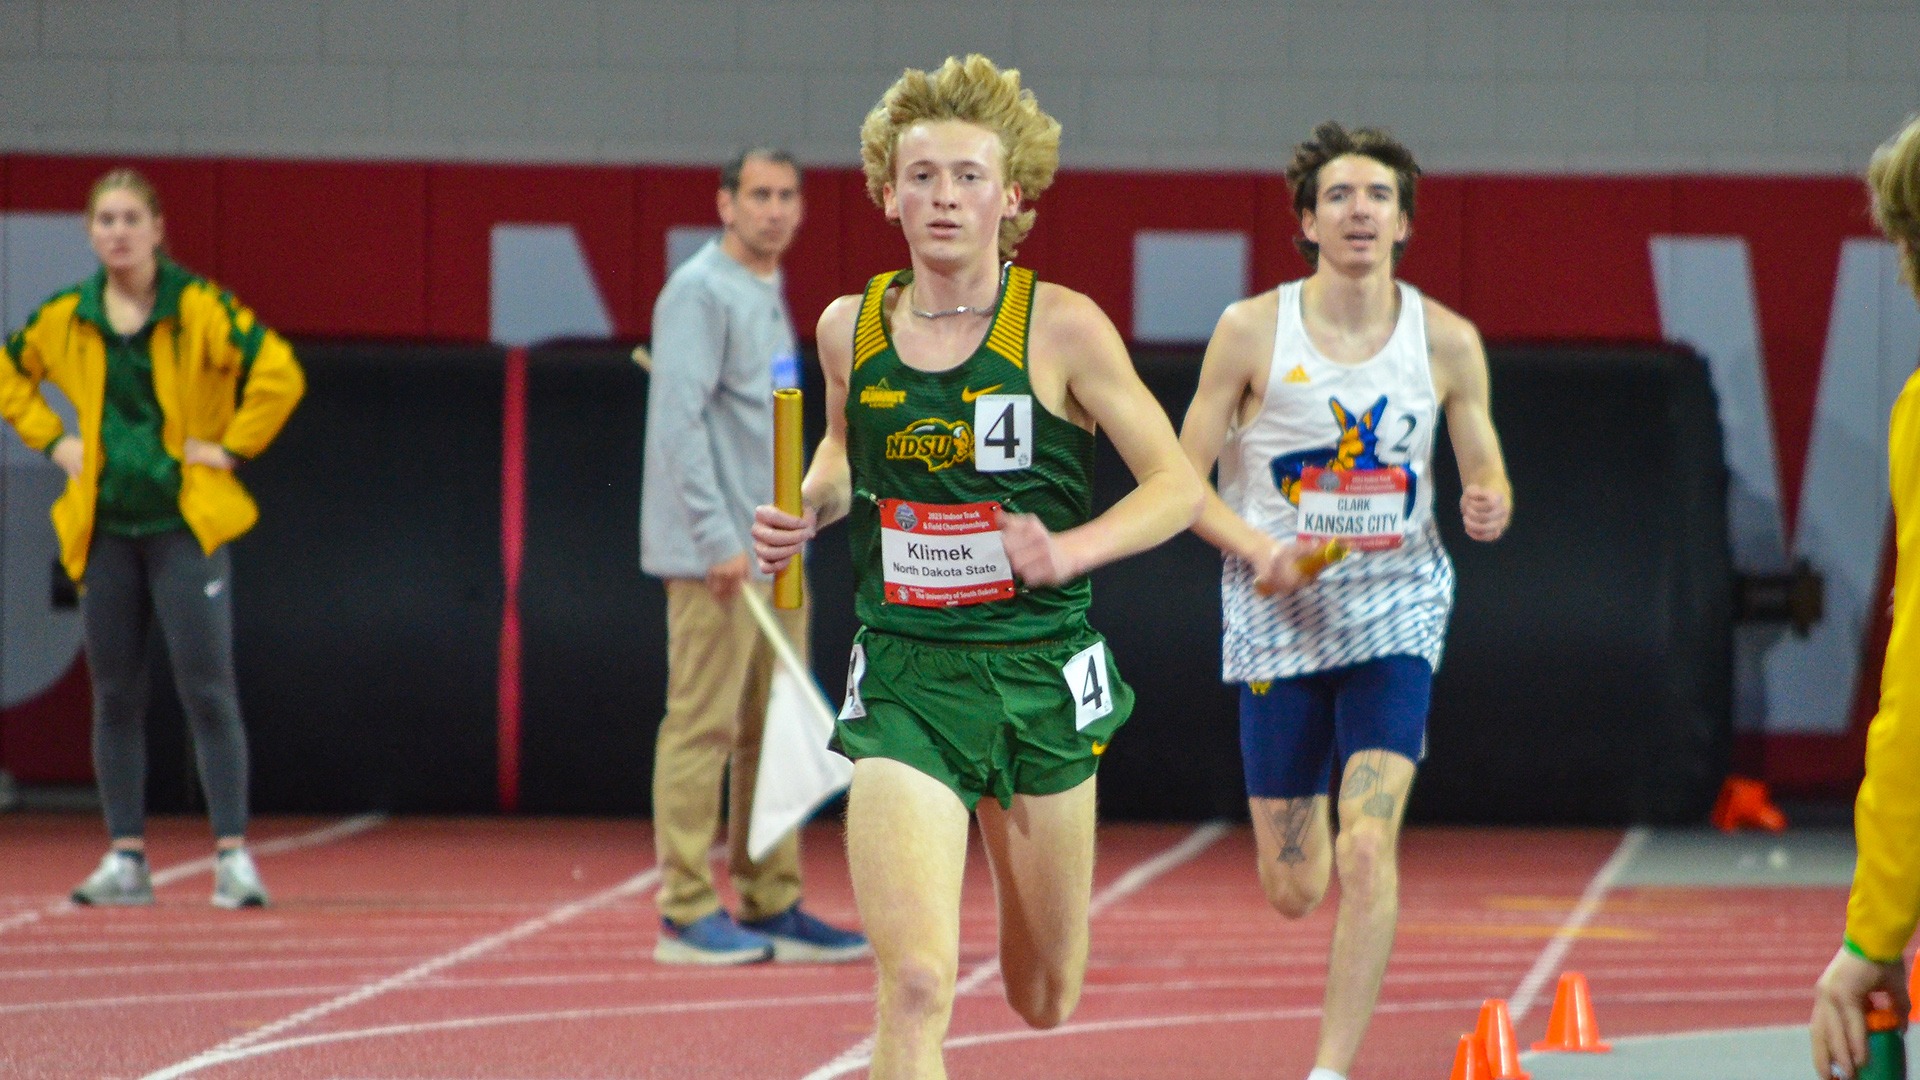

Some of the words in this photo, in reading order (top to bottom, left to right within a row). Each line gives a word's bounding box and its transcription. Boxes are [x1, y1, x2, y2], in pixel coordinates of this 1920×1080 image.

[984, 402, 1020, 459] 4
[1390, 413, 1417, 453] 2
[886, 434, 952, 459] NDSU
[1337, 498, 1371, 511] CLARK
[1304, 512, 1364, 533] KANSAS
[1367, 512, 1397, 532] CITY
[907, 541, 974, 561] Klimek
[893, 562, 920, 576] North
[922, 566, 962, 577] Dakota
[965, 563, 997, 576] State
[1082, 654, 1104, 710] 4
